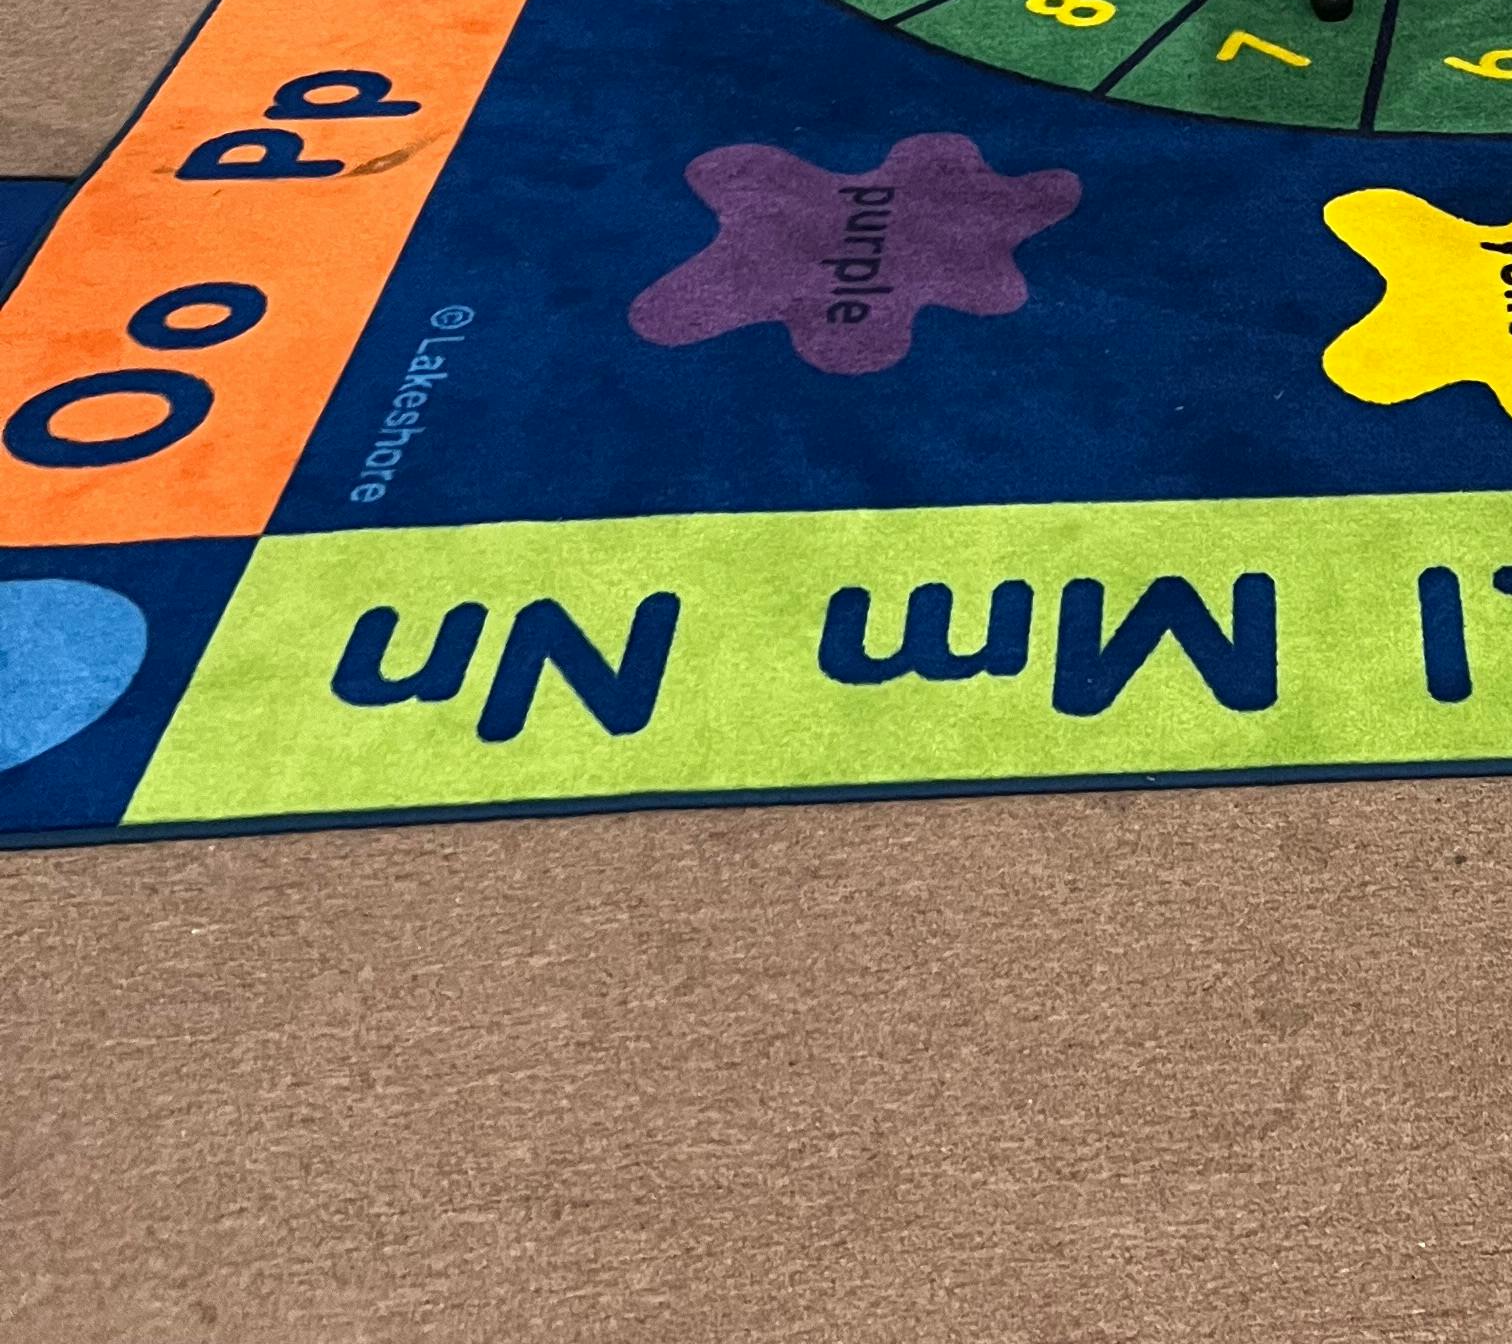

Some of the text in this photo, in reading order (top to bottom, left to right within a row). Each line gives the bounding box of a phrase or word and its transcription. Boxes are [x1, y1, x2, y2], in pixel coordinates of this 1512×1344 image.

[1216, 29, 1312, 67] 7
[1, 281, 269, 469] Oo
[174, 69, 422, 181] Pp
[818, 186, 896, 325] purple
[330, 590, 682, 744] Nn
[816, 570, 1279, 718] Mm
